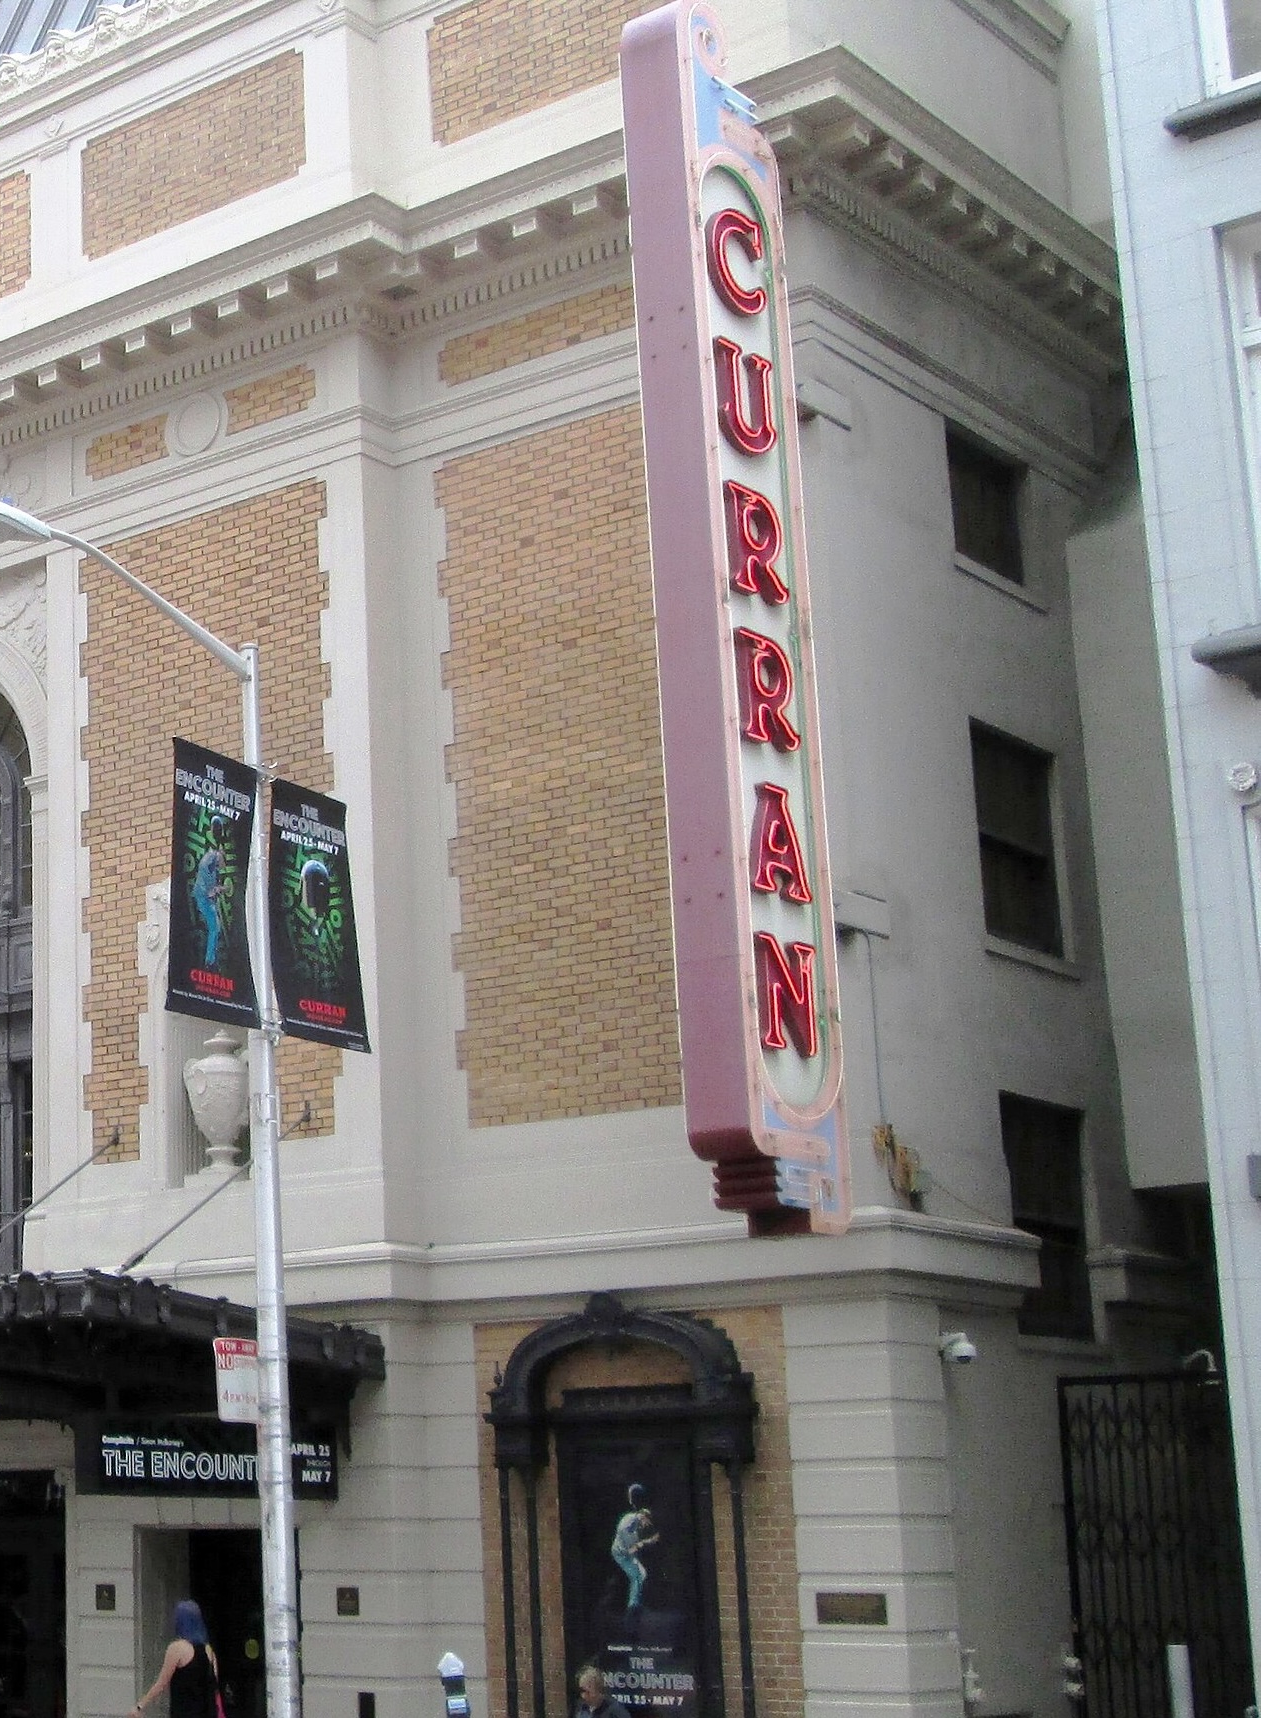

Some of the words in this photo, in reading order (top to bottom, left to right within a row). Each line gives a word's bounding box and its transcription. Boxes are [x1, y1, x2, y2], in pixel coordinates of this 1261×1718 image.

[704, 207, 818, 1057] CURRAN
[206, 764, 225, 783] THE
[175, 768, 251, 812] ENCOUNTER
[184, 791, 206, 808] APRIL
[219, 804, 235, 819] MAY
[234, 811, 241, 821] 7
[300, 803, 319, 821] THE
[273, 808, 346, 847] ENCOUNTER
[280, 830, 303, 844] APRIL
[303, 836, 314, 847] 25
[318, 840, 333, 854] MAY
[333, 846, 339, 856] 7
[190, 968, 234, 991] CURRAN
[299, 999, 347, 1018] CURRAN
[218, 1354, 234, 1369] NO
[289, 1443, 316, 1456] APRIL
[318, 1445, 331, 1457] 25
[102, 1450, 145, 1478] THE
[151, 1451, 259, 1480] ENCOUNT
[301, 1470, 322, 1483] MAY
[324, 1470, 331, 1483] 7
[629, 1657, 655, 1669] THE
[601, 1671, 694, 1690] NCOUNTER
[634, 1694, 646, 1705] 25
[652, 1695, 675, 1706] MAY
[676, 1696, 684, 1706] 7
